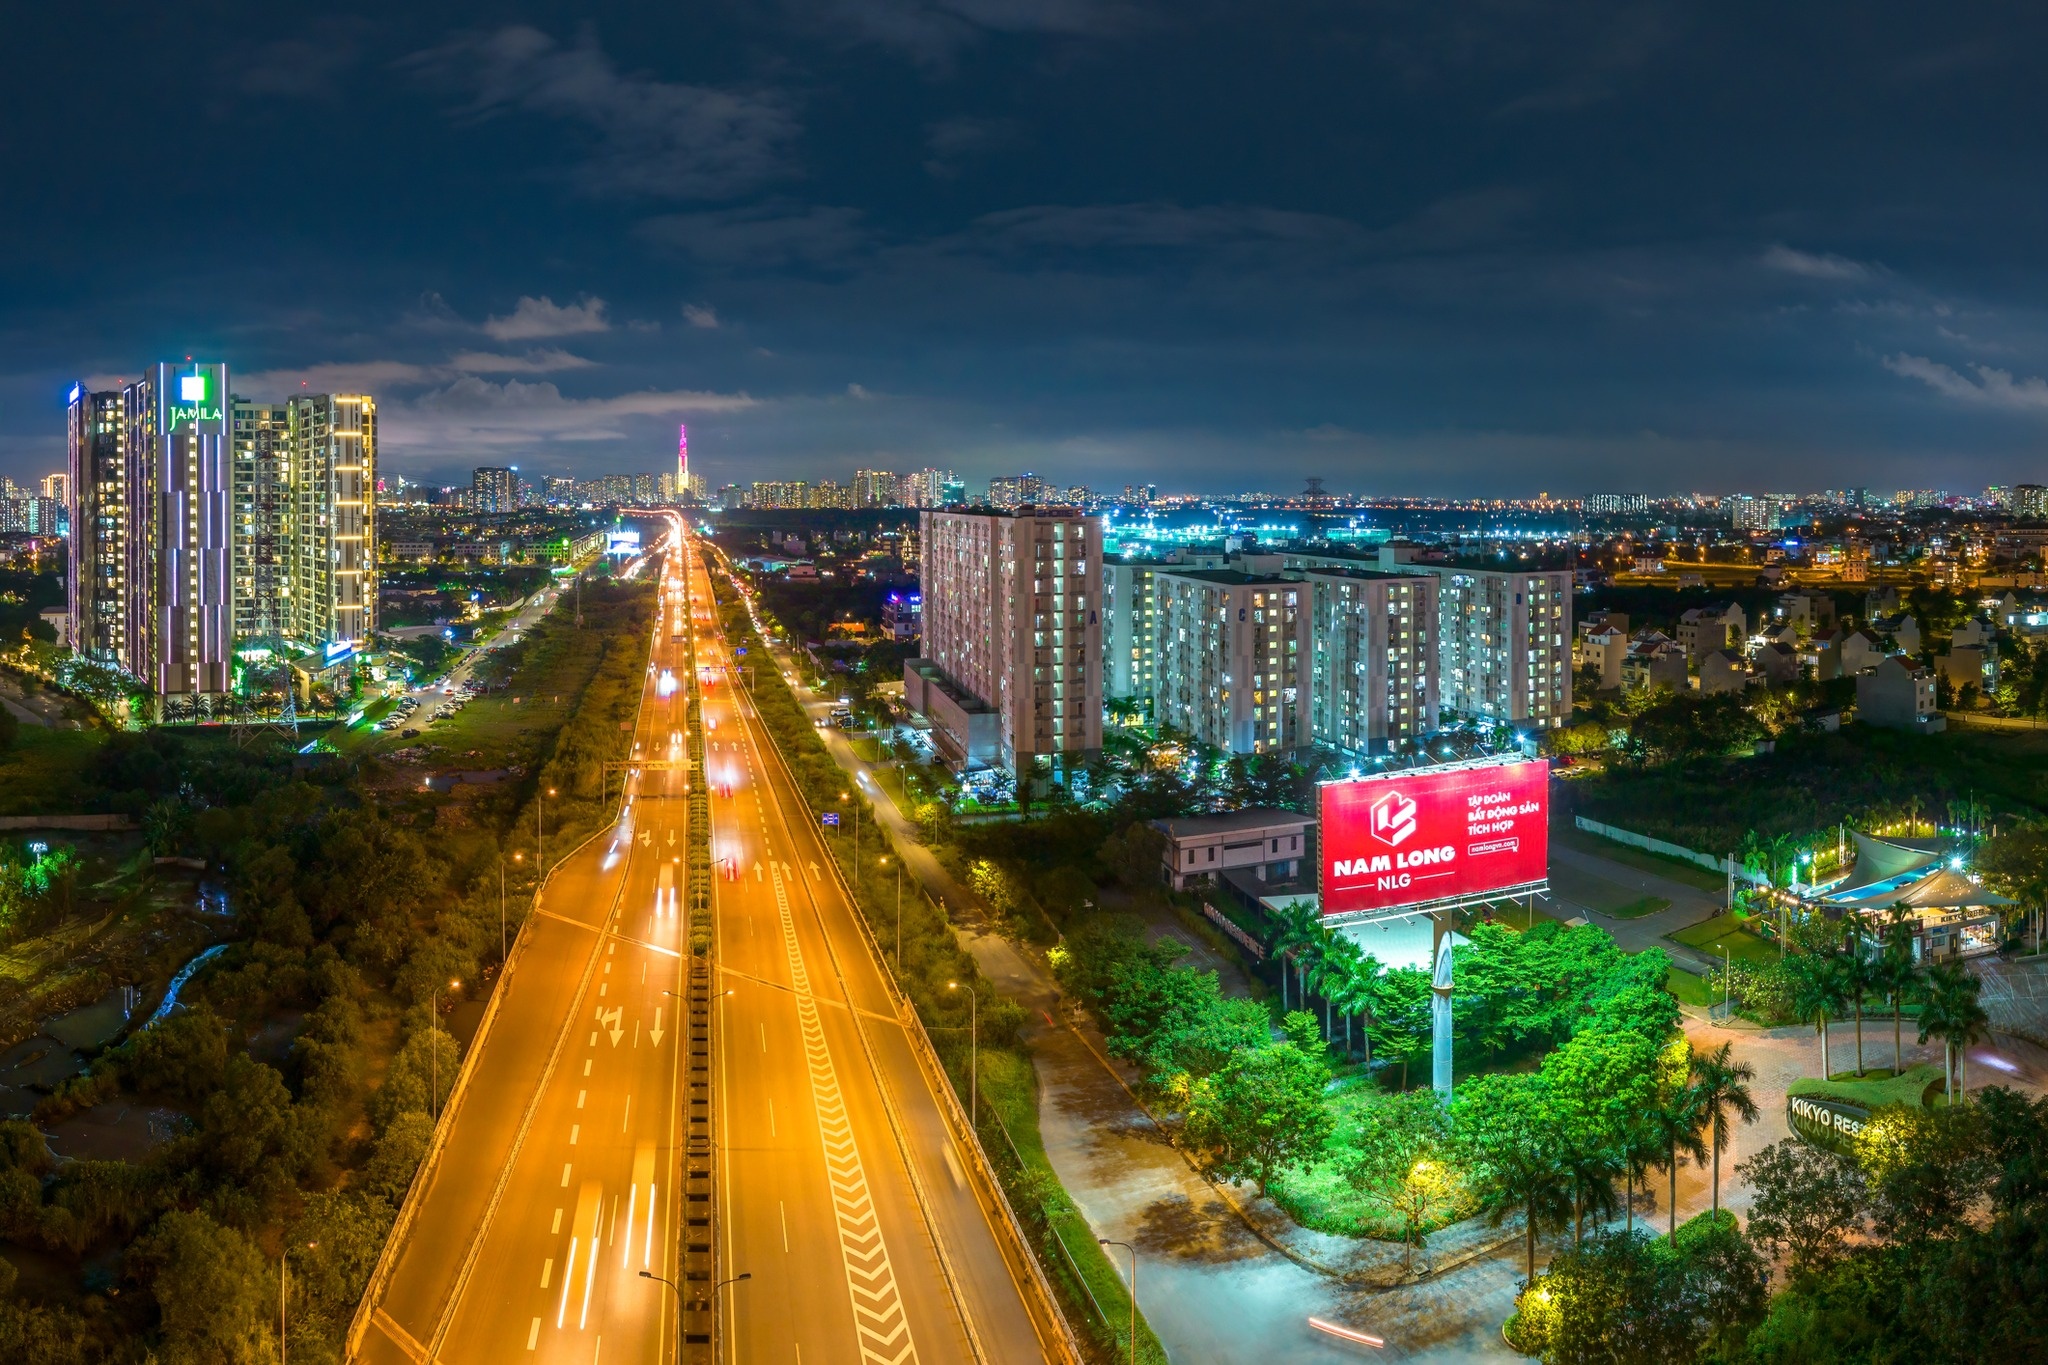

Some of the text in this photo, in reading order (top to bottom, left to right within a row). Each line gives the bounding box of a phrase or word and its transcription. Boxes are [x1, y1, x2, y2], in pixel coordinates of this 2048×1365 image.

[169, 406, 223, 432] JAMILA
[1089, 610, 1097, 625] A
[1238, 607, 1246, 622] C
[1467, 820, 1514, 836] TÍCH HỢP
[1471, 840, 1516, 853] namlongvn.com
[1333, 845, 1456, 877] NAM LONG
[1377, 872, 1412, 892] NLG
[1791, 1096, 1832, 1127] KIKYO
